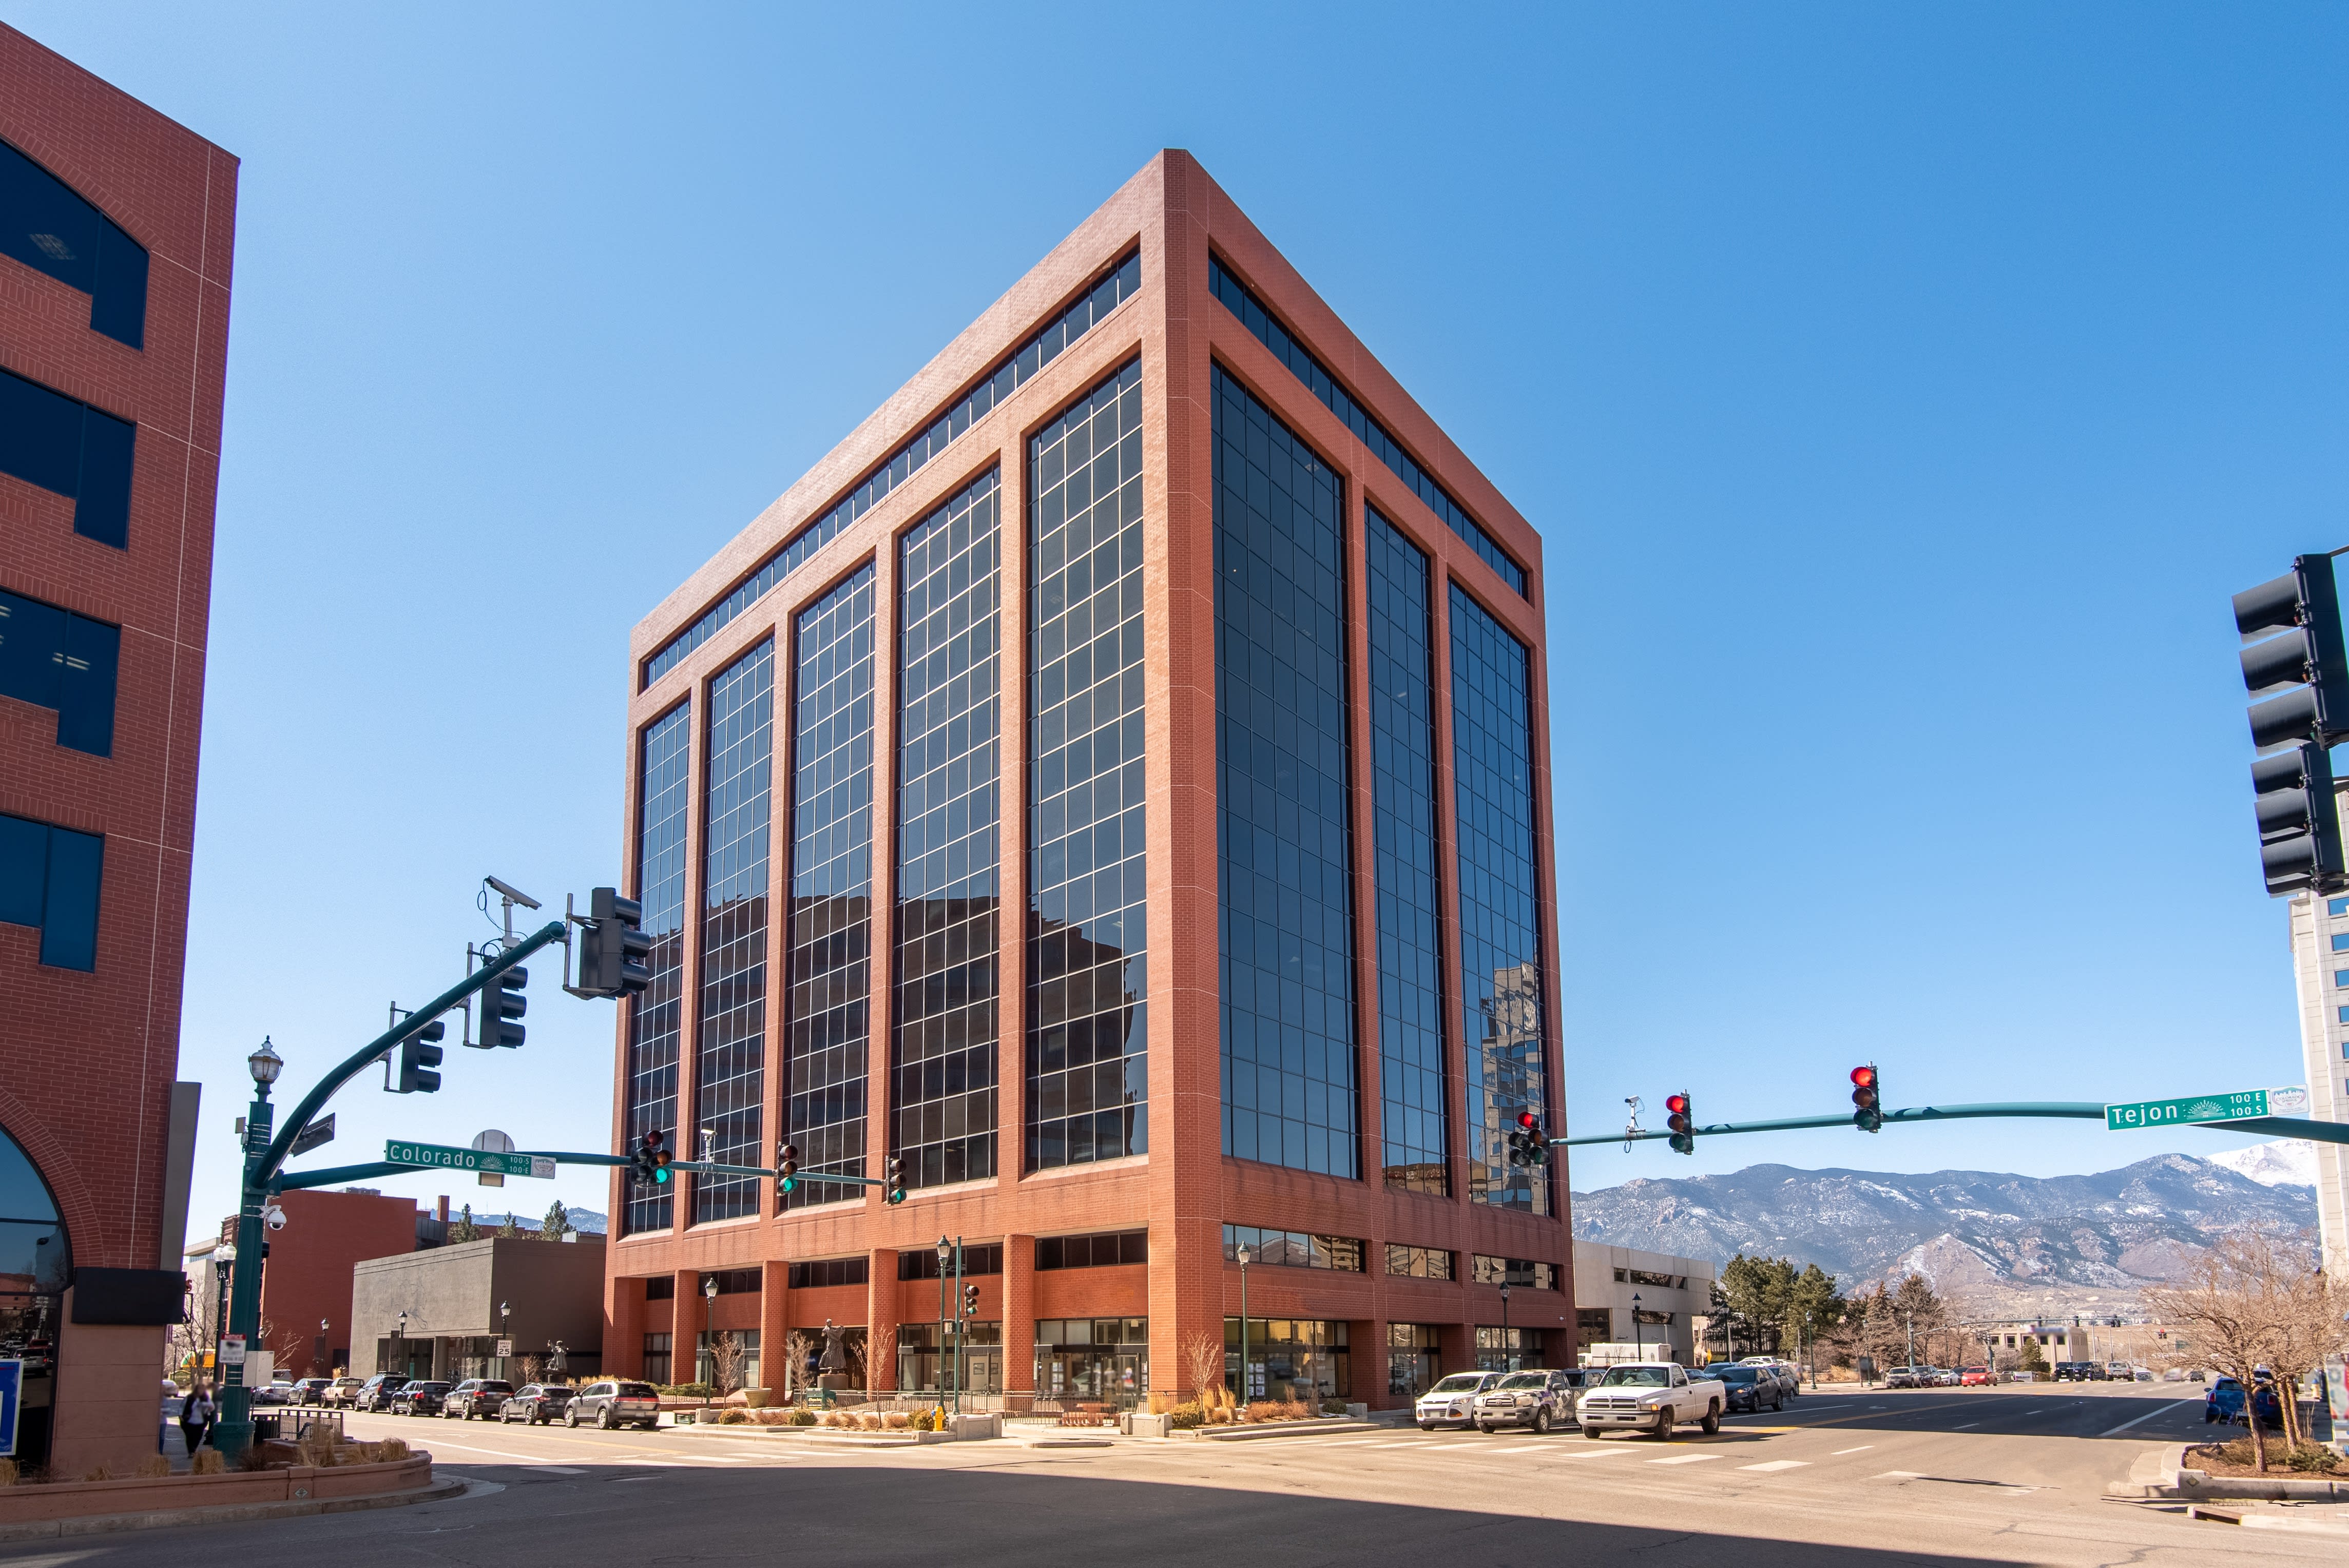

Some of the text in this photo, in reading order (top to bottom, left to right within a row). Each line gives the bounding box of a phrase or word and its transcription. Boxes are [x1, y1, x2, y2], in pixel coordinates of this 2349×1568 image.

[2230, 1092, 2261, 1104] 100 E
[2191, 1104, 2220, 1114] DOWNTOWN
[2230, 1105, 2262, 1117] 100 S
[2112, 1105, 2177, 1126] Tejon
[390, 1145, 475, 1167] Colorado
